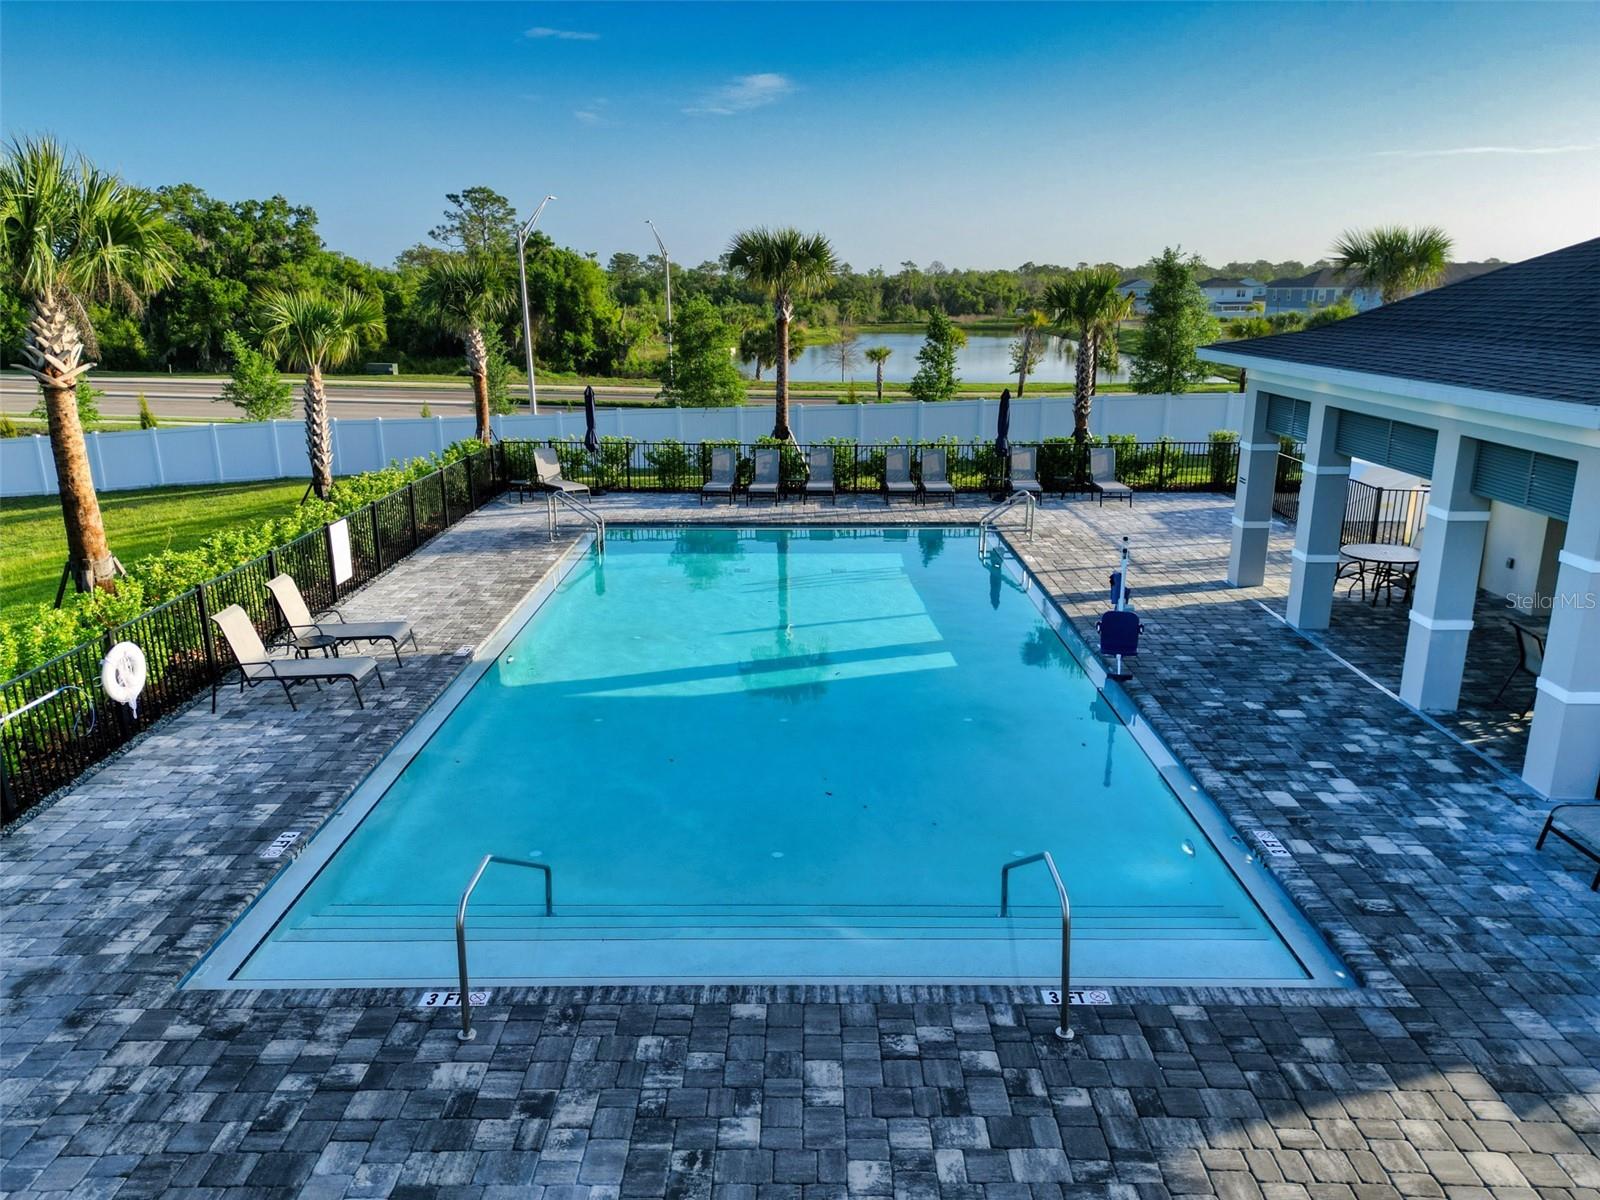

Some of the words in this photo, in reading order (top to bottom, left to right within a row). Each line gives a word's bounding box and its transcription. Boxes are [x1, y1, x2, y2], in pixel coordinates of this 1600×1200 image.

[271, 840, 292, 848] FT
[1261, 839, 1282, 848] FT
[426, 993, 439, 1006] 3
[1048, 991, 1060, 1004] 3
[1067, 991, 1085, 1004] FT
